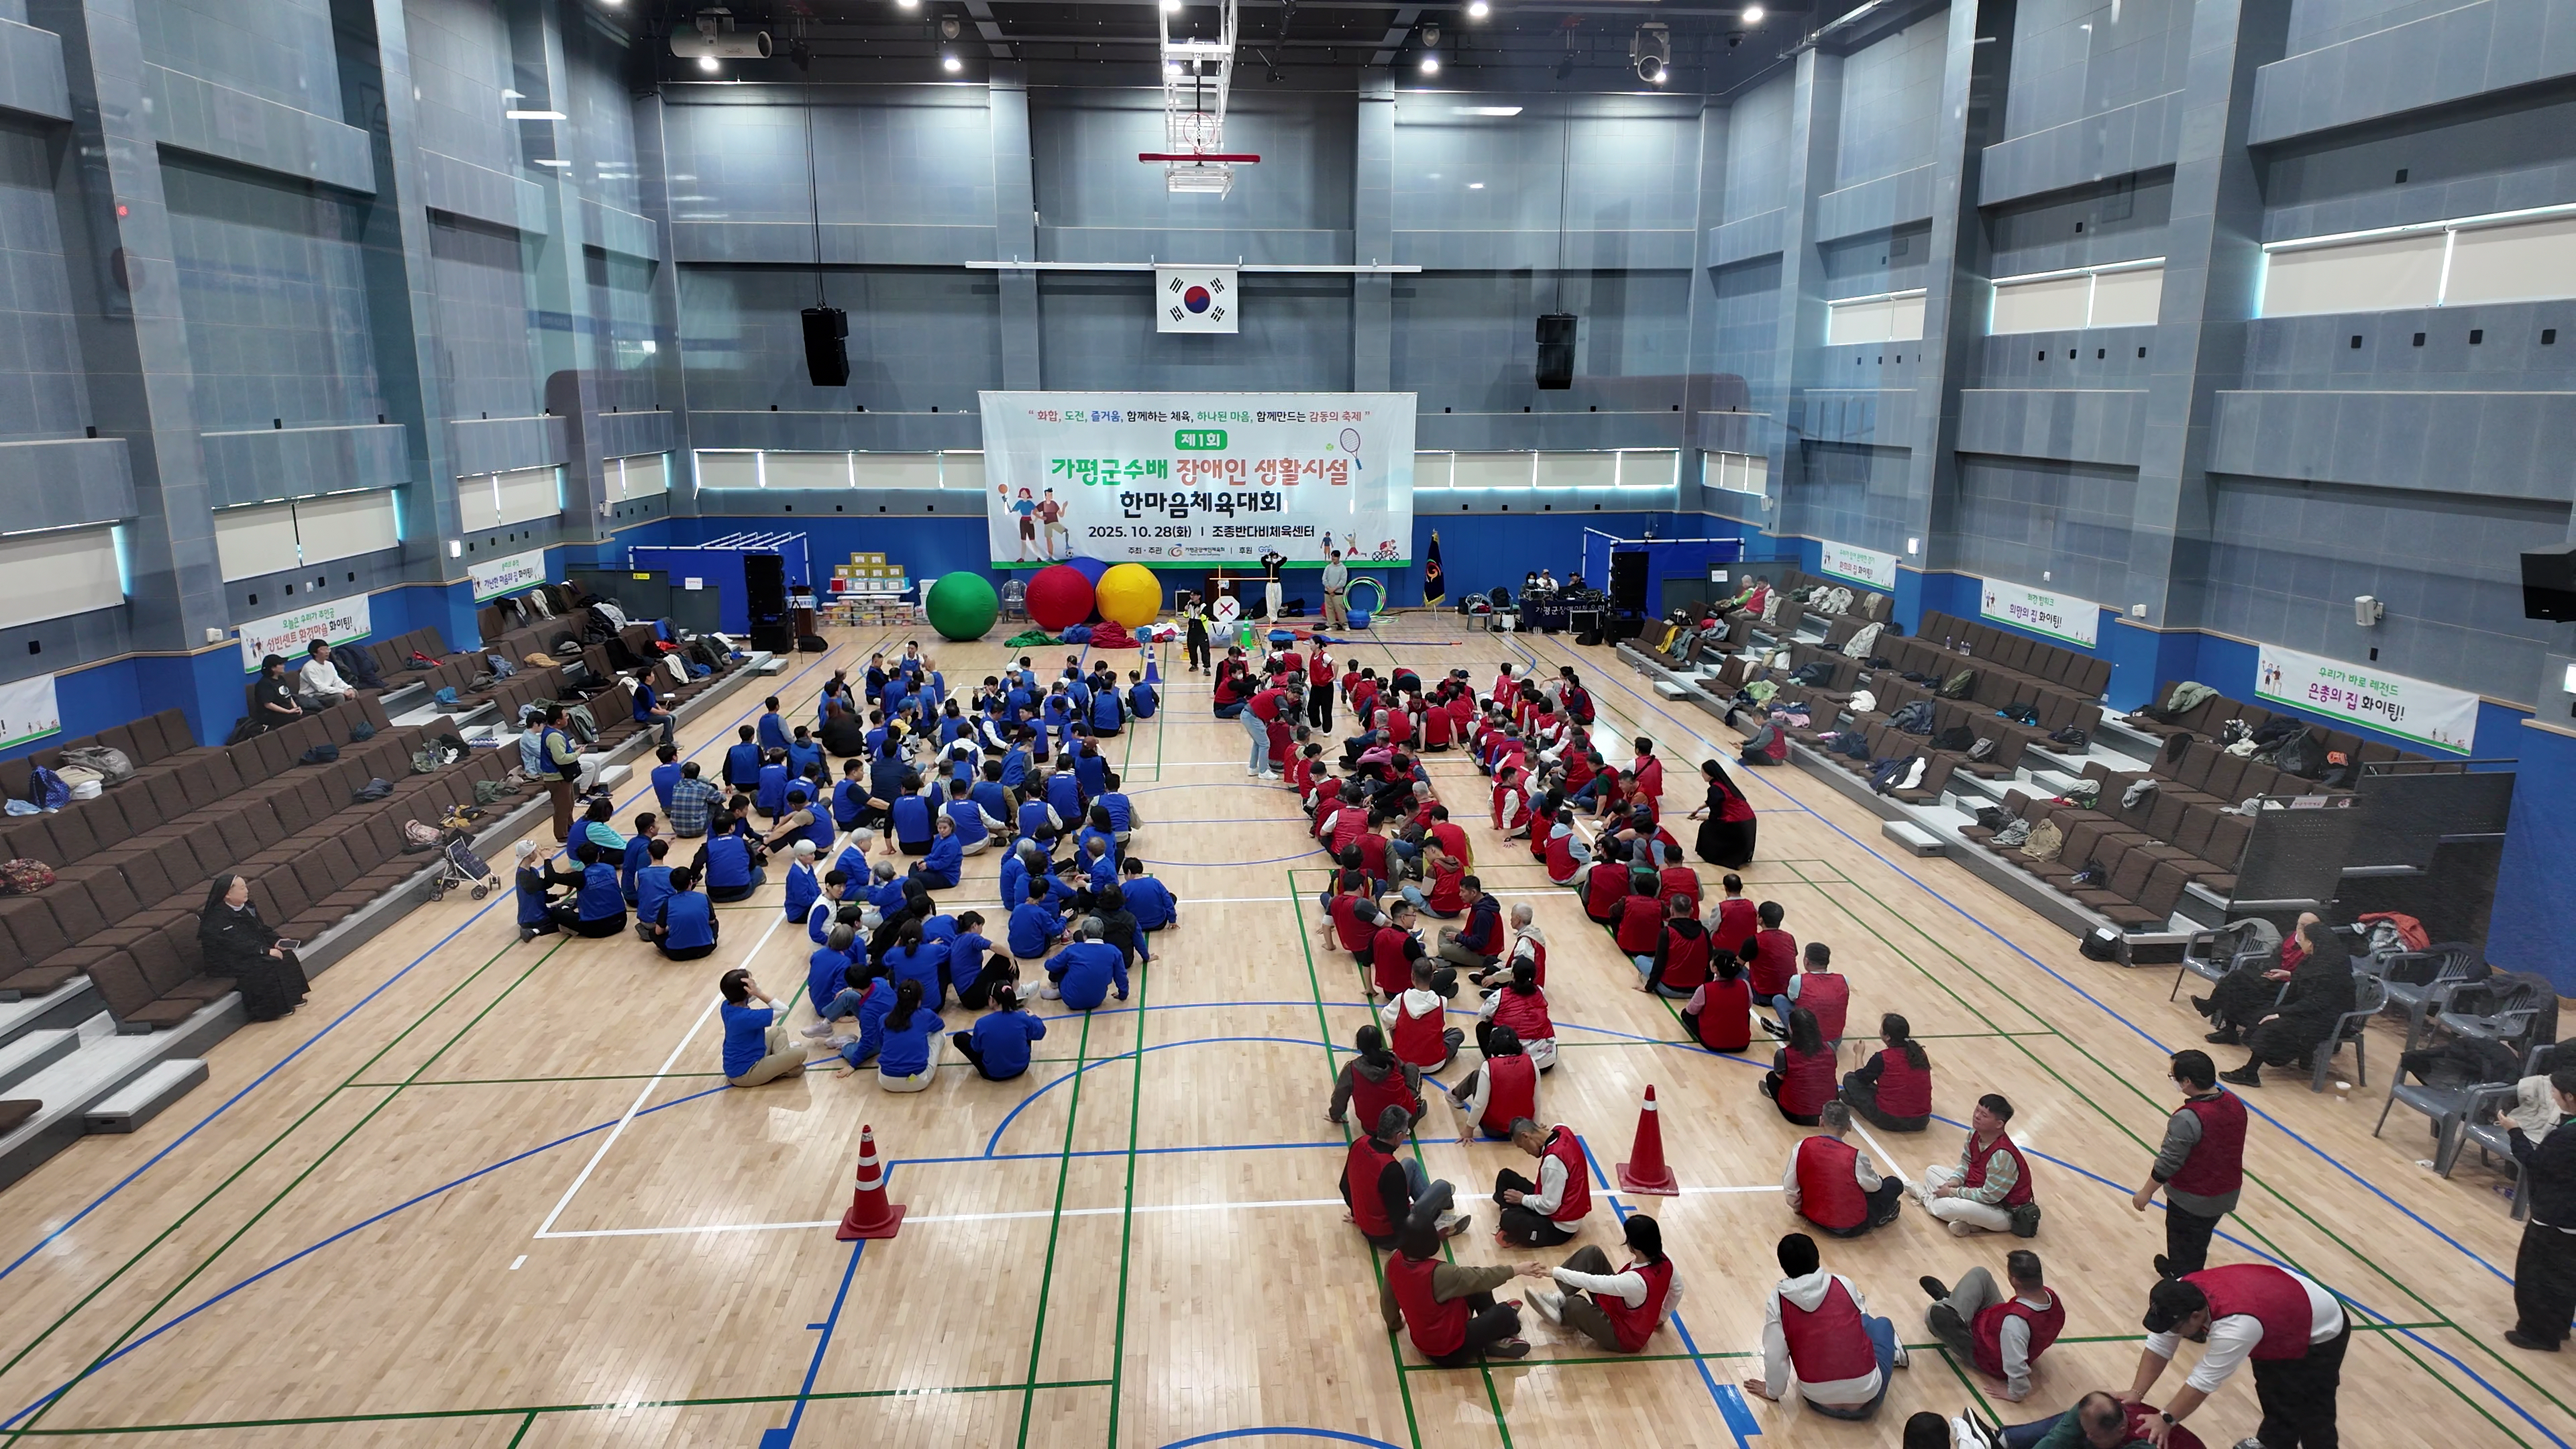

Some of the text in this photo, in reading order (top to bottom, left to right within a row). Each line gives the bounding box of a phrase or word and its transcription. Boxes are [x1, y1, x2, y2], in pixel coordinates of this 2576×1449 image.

[1037, 411, 1062, 423] 화합,
[1065, 411, 1087, 423] 도전,
[1091, 411, 1124, 423] 즐거움,
[1127, 411, 1167, 422] 함께하는
[1171, 411, 1194, 423] 체육,
[1197, 411, 1227, 422] 하나된
[1230, 411, 1253, 423] 마음,
[1256, 411, 1306, 423] 함께만드는
[1309, 411, 1338, 423] 감동의
[1342, 411, 1361, 422] 축제
[1181, 433, 1220, 447] 제1회
[1052, 458, 1348, 486] 가평군수배 장애인 생활시설
[1120, 490, 1281, 519] 한마음체육대회
[1088, 525, 1315, 538] 2025. 10. 28(화) 조종반다비체육센터
[282, 608, 335, 630] 오늘은 우리가 주인공
[2009, 604, 2062, 629] 희망의 집 화이팅!
[267, 616, 353, 652] 성빈센트 환경마을 화이팅!
[2318, 667, 2399, 697] 우리가 바로 레전드
[2308, 683, 2405, 722] 은총의 집 화이팅!
